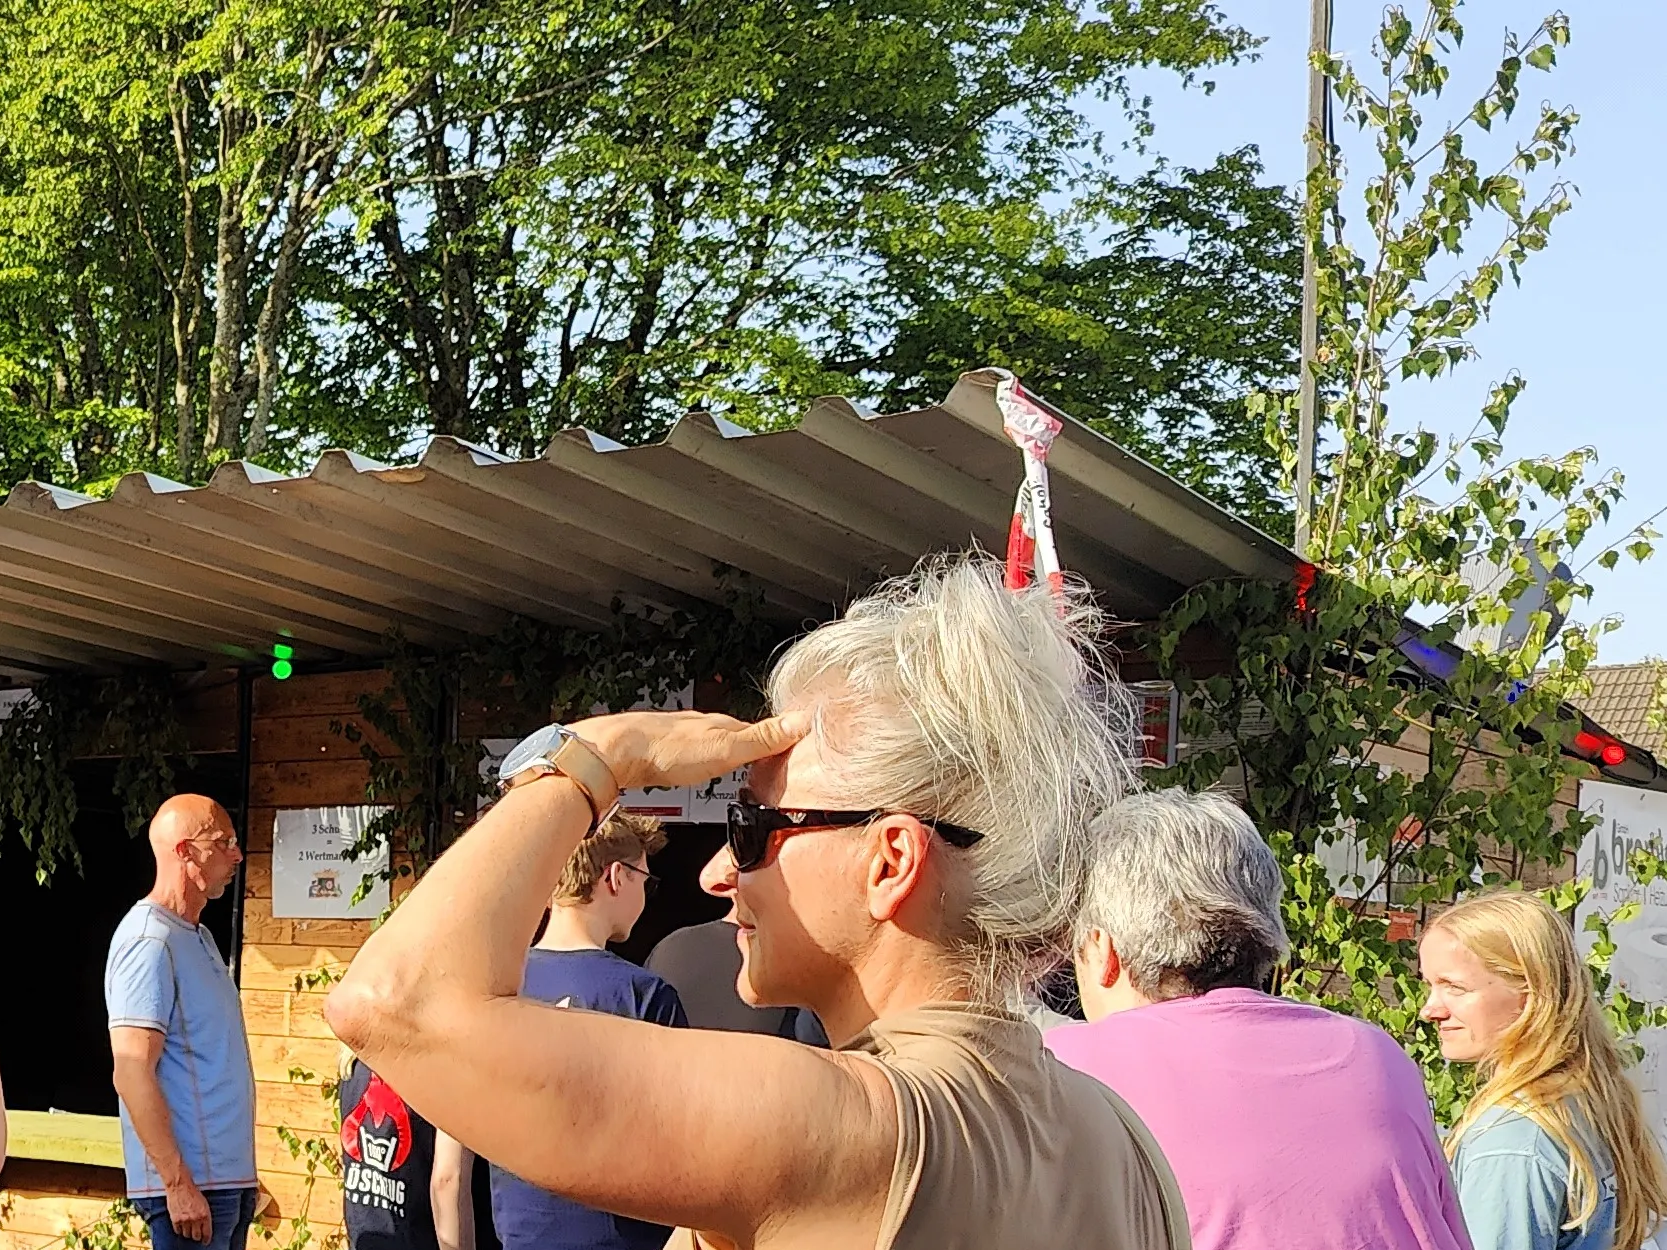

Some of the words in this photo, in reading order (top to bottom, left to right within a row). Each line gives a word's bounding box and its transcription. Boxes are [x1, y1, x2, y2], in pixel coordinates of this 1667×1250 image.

[312, 824, 319, 836] 3
[320, 824, 341, 836] Schu
[298, 851, 305, 861] 2
[306, 850, 343, 861] Wertmar
